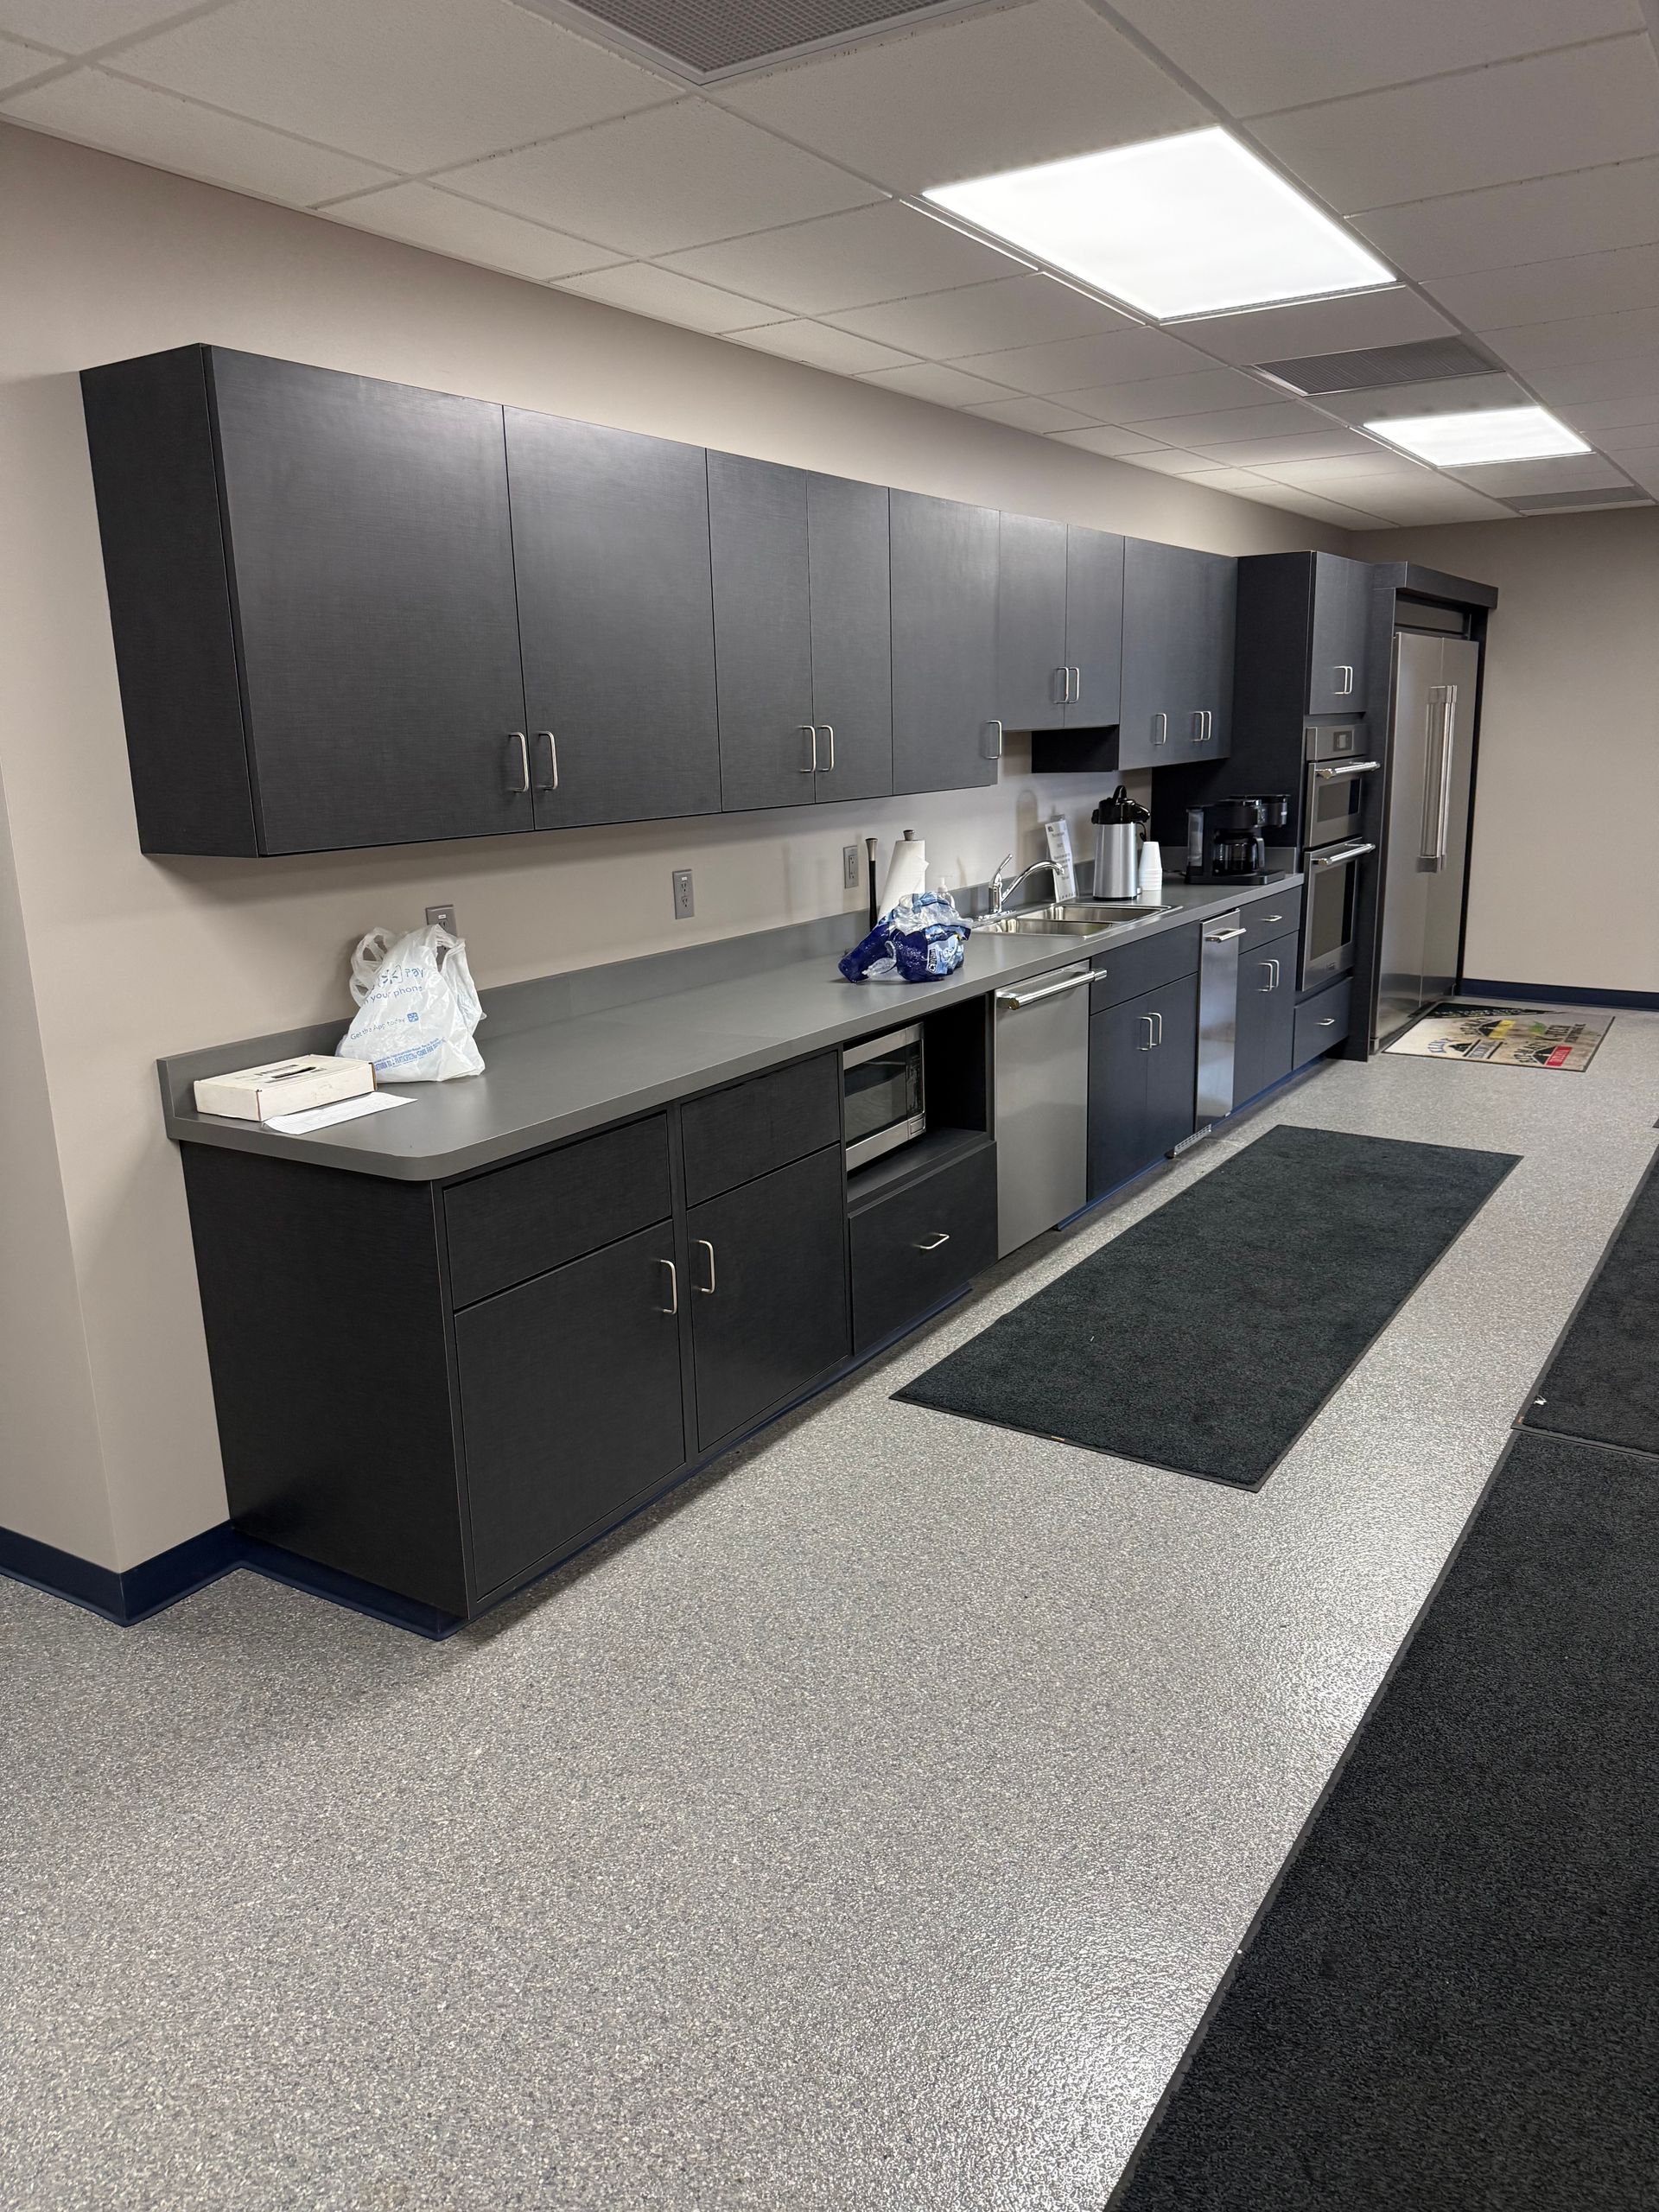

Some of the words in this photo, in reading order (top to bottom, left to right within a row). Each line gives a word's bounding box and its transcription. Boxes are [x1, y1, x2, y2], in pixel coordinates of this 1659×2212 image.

[404, 967, 424, 978] Pay
[371, 991, 391, 1002] your
[393, 985, 423, 999] phone
[350, 1032, 363, 1040] Get
